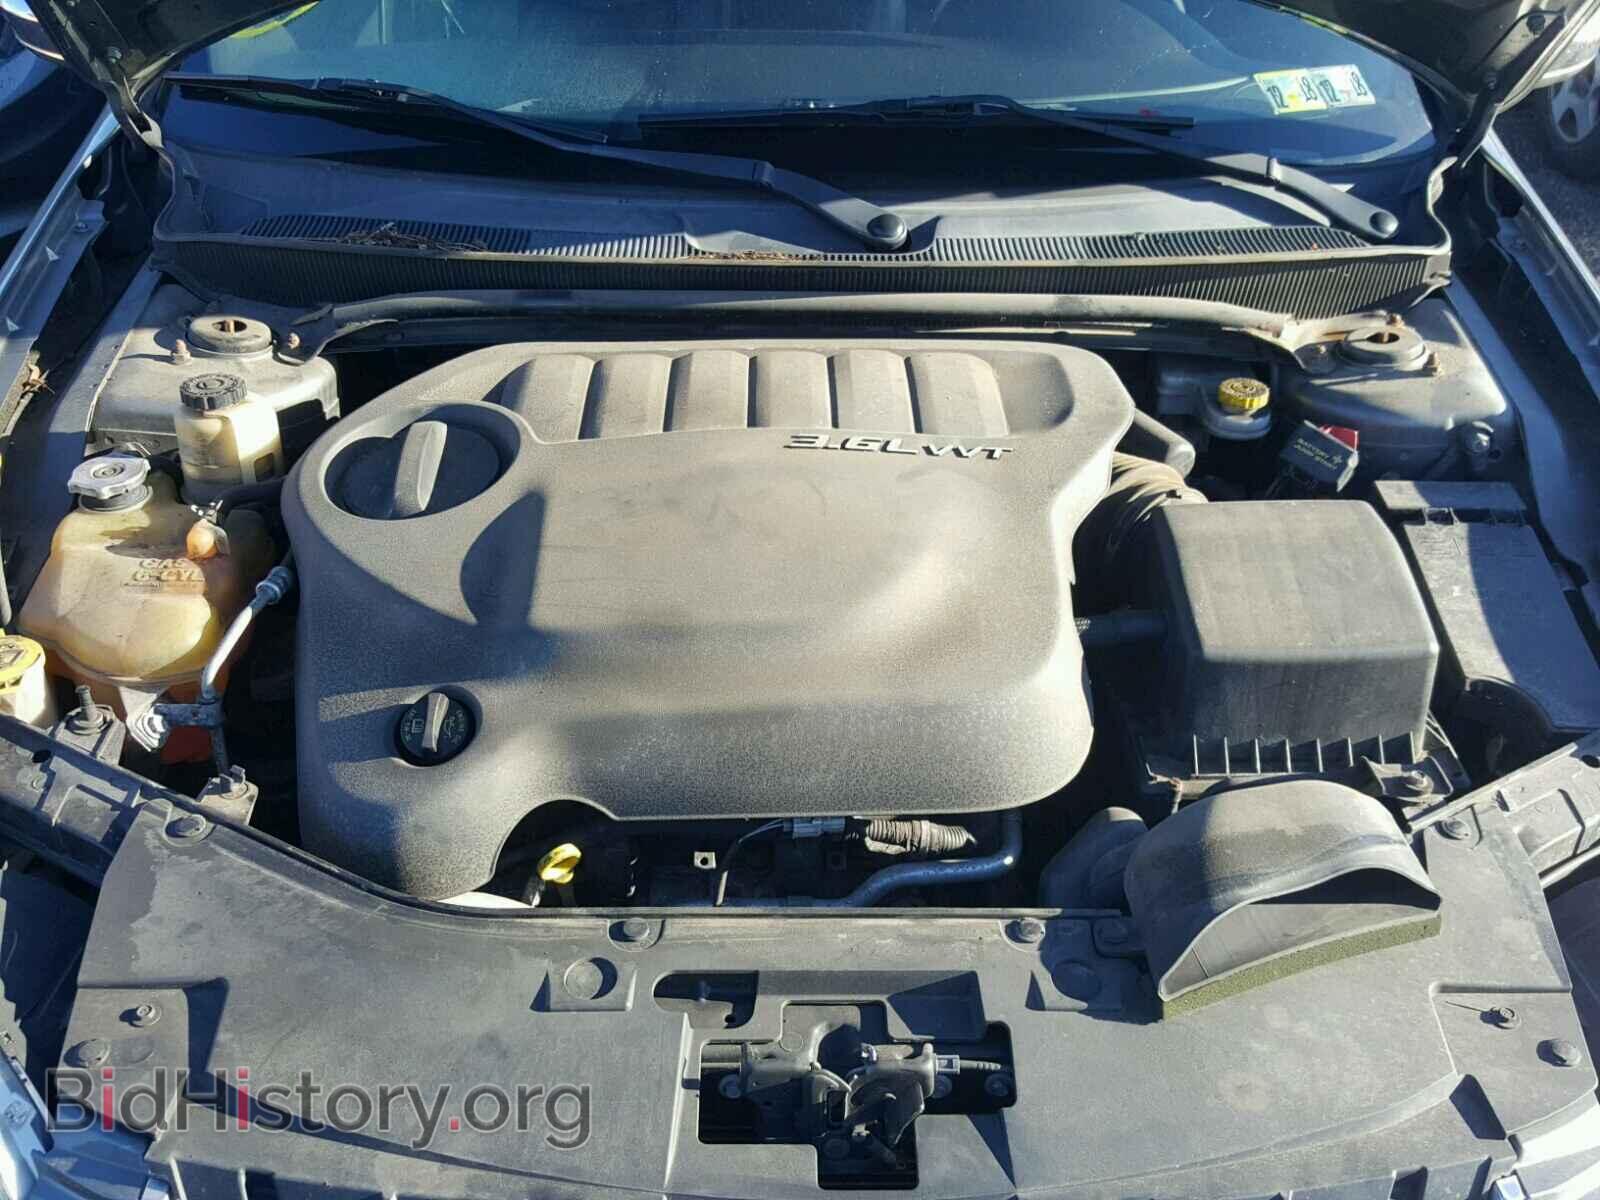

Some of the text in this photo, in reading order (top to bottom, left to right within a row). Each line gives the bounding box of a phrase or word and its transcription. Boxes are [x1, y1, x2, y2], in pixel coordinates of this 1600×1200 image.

[1266, 75, 1318, 108] 12 18
[1319, 79, 1341, 102] 12
[783, 434, 1013, 460] 3.6L VVT
[1297, 438, 1330, 459] BATTERY
